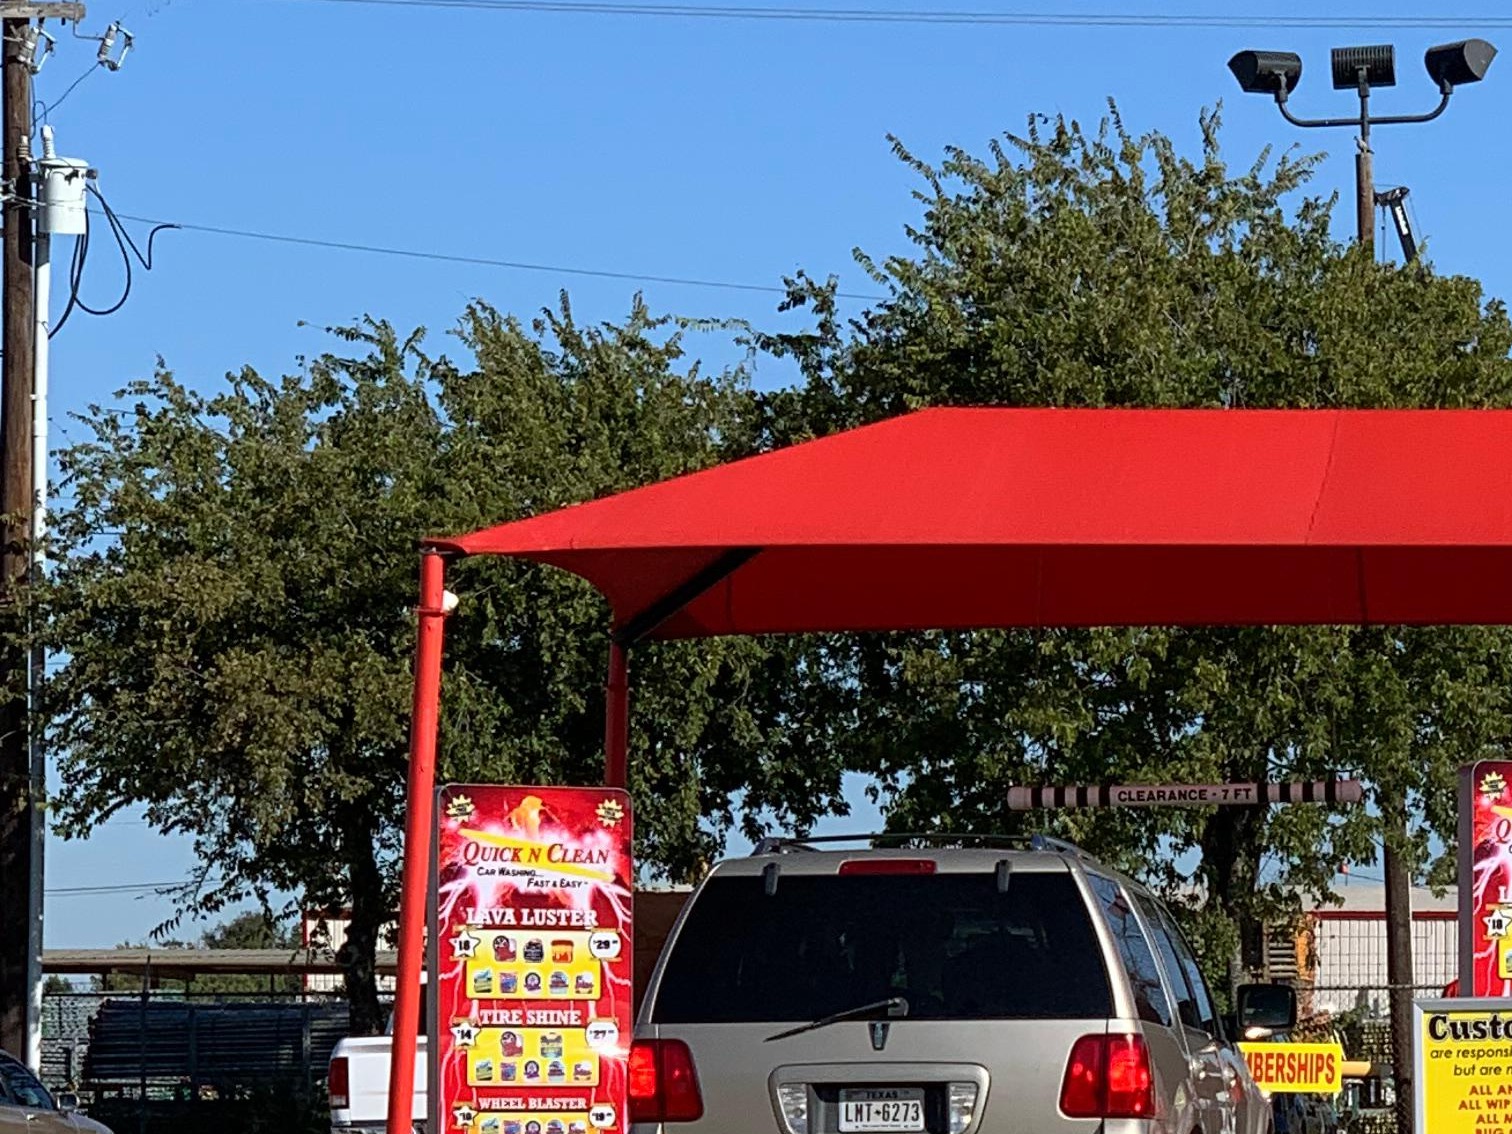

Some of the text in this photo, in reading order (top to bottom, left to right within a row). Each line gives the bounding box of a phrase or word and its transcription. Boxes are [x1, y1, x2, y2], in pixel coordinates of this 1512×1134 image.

[1117, 788, 1208, 803] CLEARANCE
[1222, 788, 1230, 801] 7
[1233, 787, 1252, 800] FT
[463, 841, 610, 866] QUICK N CLEAN
[476, 866, 497, 877] CAR
[526, 877, 549, 888] FAST
[466, 908, 599, 927] LAVA LUSTER
[480, 1009, 582, 1025] TIRE SHINE
[1430, 1049, 1453, 1059] are
[1453, 1064, 1476, 1076] but
[1479, 1066, 1502, 1076] are
[866, 1090, 899, 1100] TEXAS
[1469, 1085, 1493, 1096] ALL
[478, 1097, 587, 1110] WHEEL BLASTER
[1458, 1099, 1482, 1110] ALL
[1476, 1114, 1499, 1124] ALL
